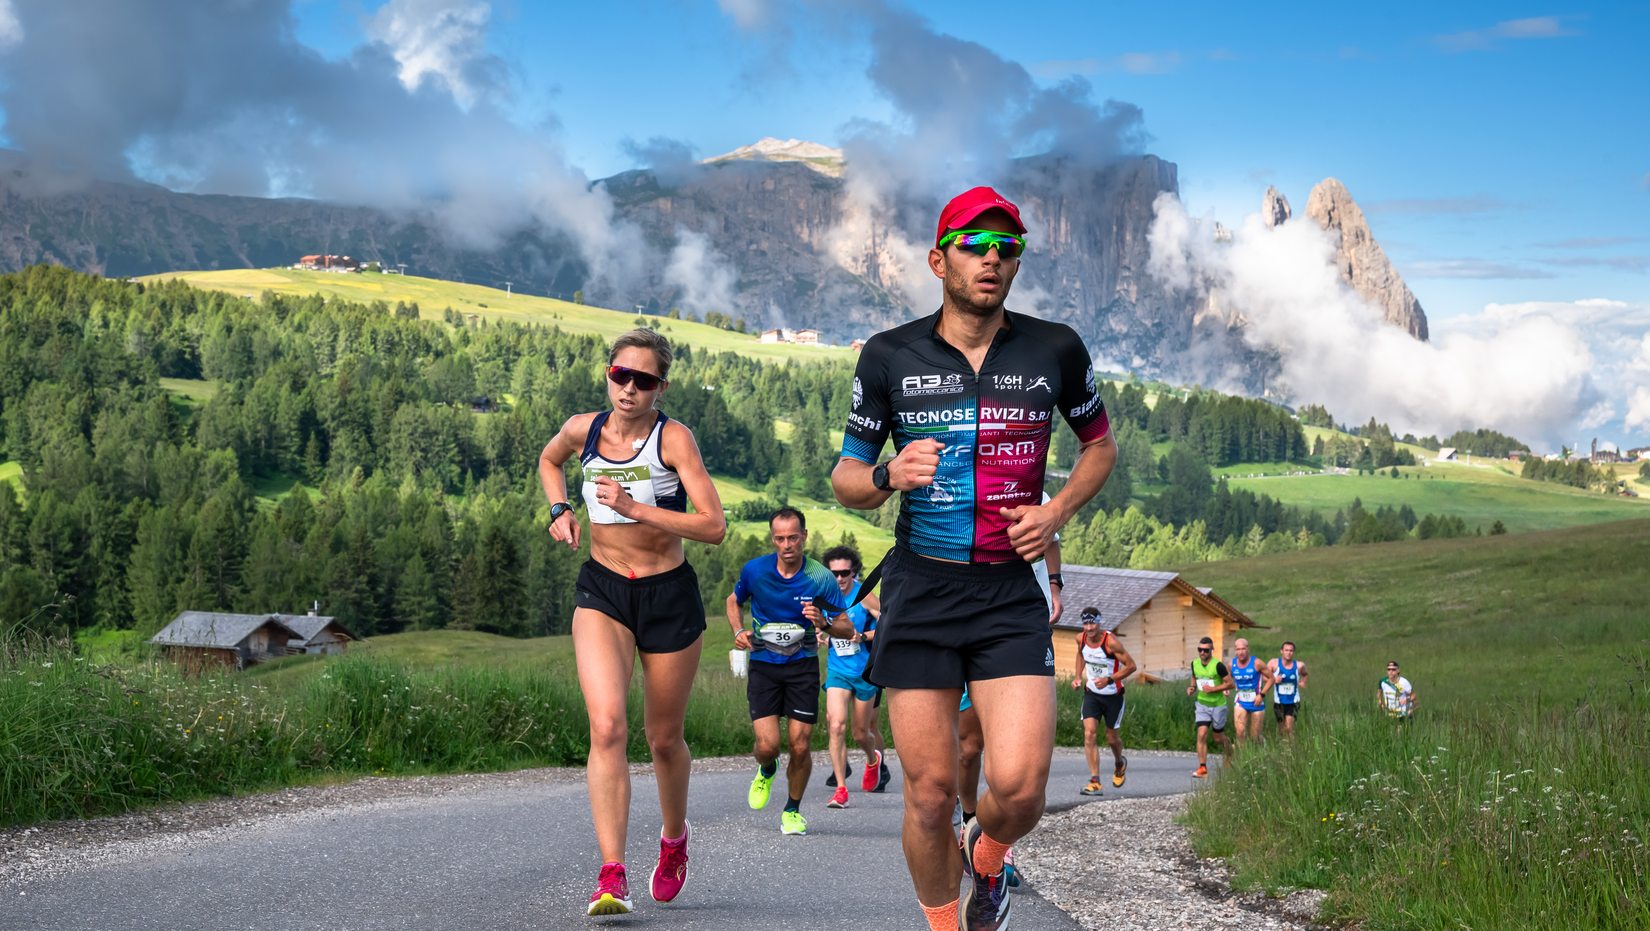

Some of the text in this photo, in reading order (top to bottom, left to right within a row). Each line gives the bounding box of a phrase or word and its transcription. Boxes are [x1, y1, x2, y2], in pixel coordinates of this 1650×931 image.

[902, 374, 941, 389] A3
[992, 374, 1022, 385] 1/6H
[775, 632, 791, 641] 36
